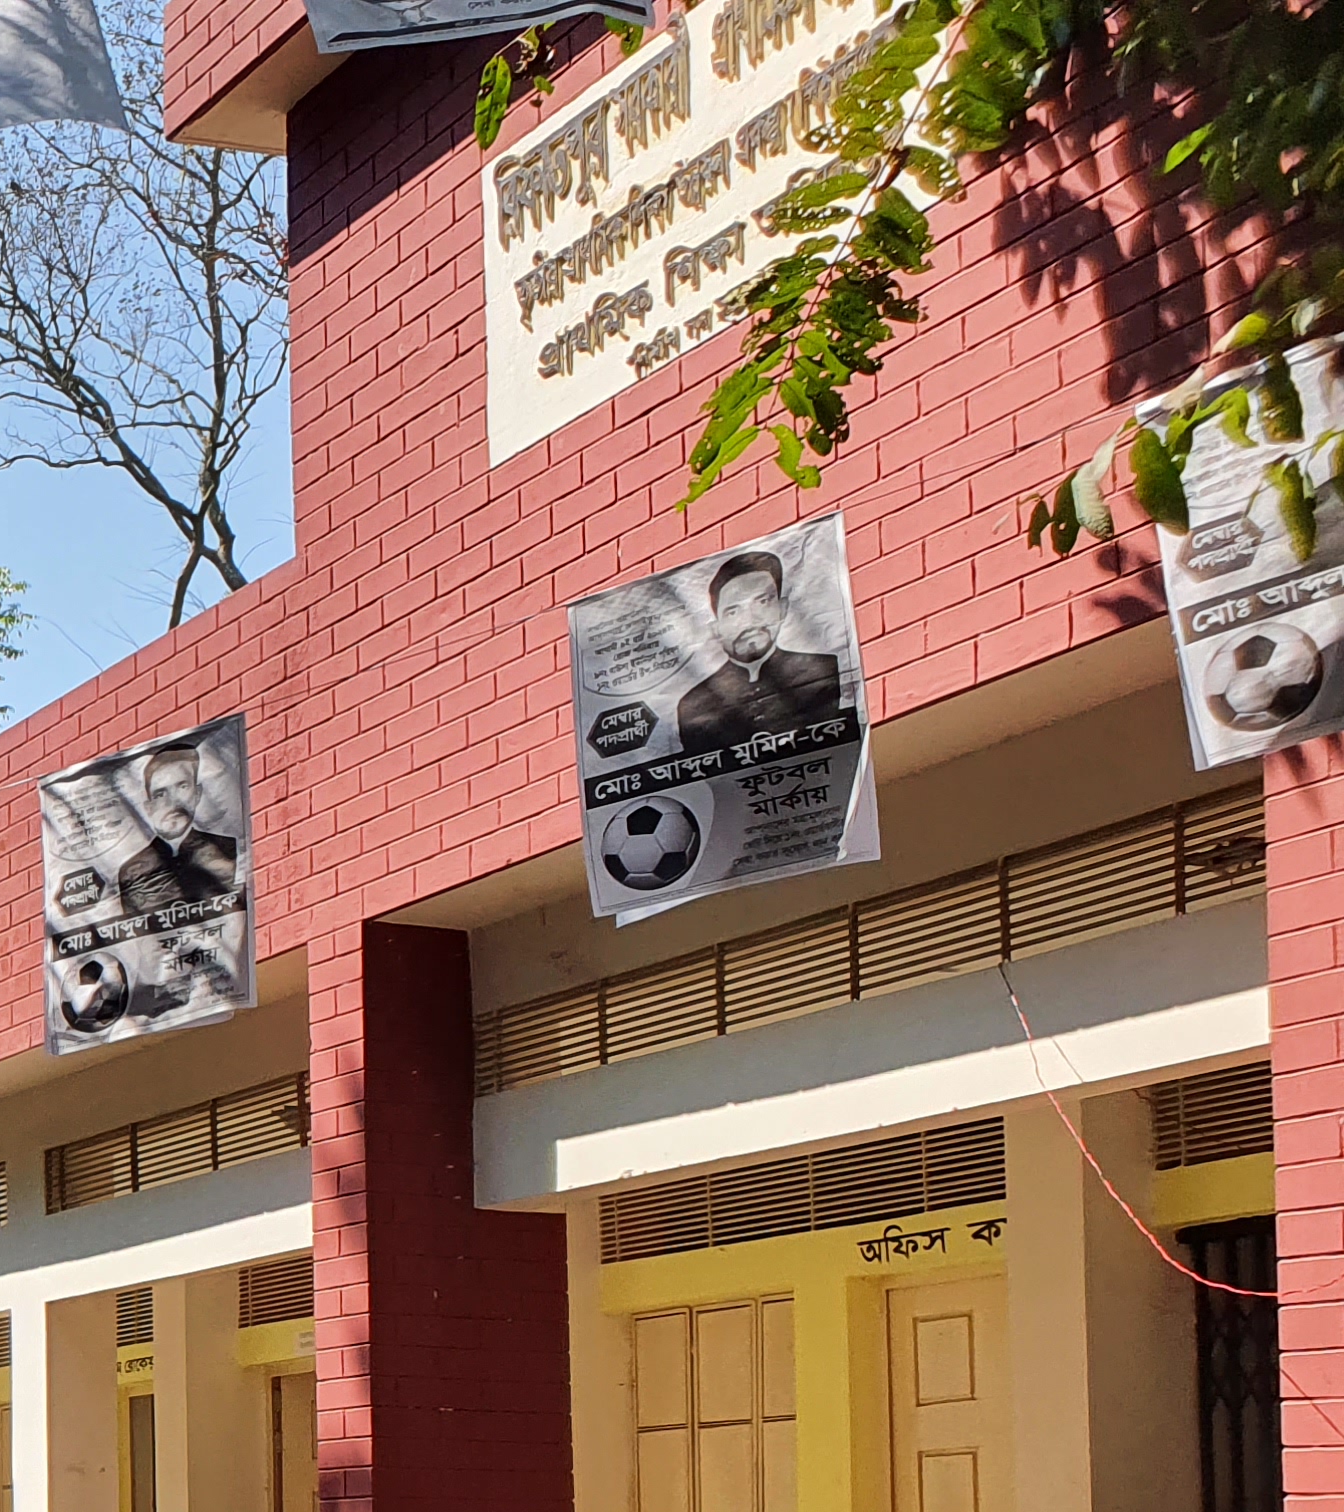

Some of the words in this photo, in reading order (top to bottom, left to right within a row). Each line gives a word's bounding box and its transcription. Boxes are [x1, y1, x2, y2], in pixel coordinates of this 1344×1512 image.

[1191, 600, 1253, 635] মোঃ
[601, 706, 643, 730] মেম্বার
[594, 774, 642, 802] মোঃ
[648, 749, 722, 783] আব্দুল
[729, 716, 848, 765] মুমিন-কে
[734, 756, 832, 797] ফুটবল
[747, 782, 831, 816] মার্কায়
[58, 933, 92, 955] মোঃ
[97, 914, 150, 938] আব্দুল
[856, 1223, 951, 1264] অফিস
